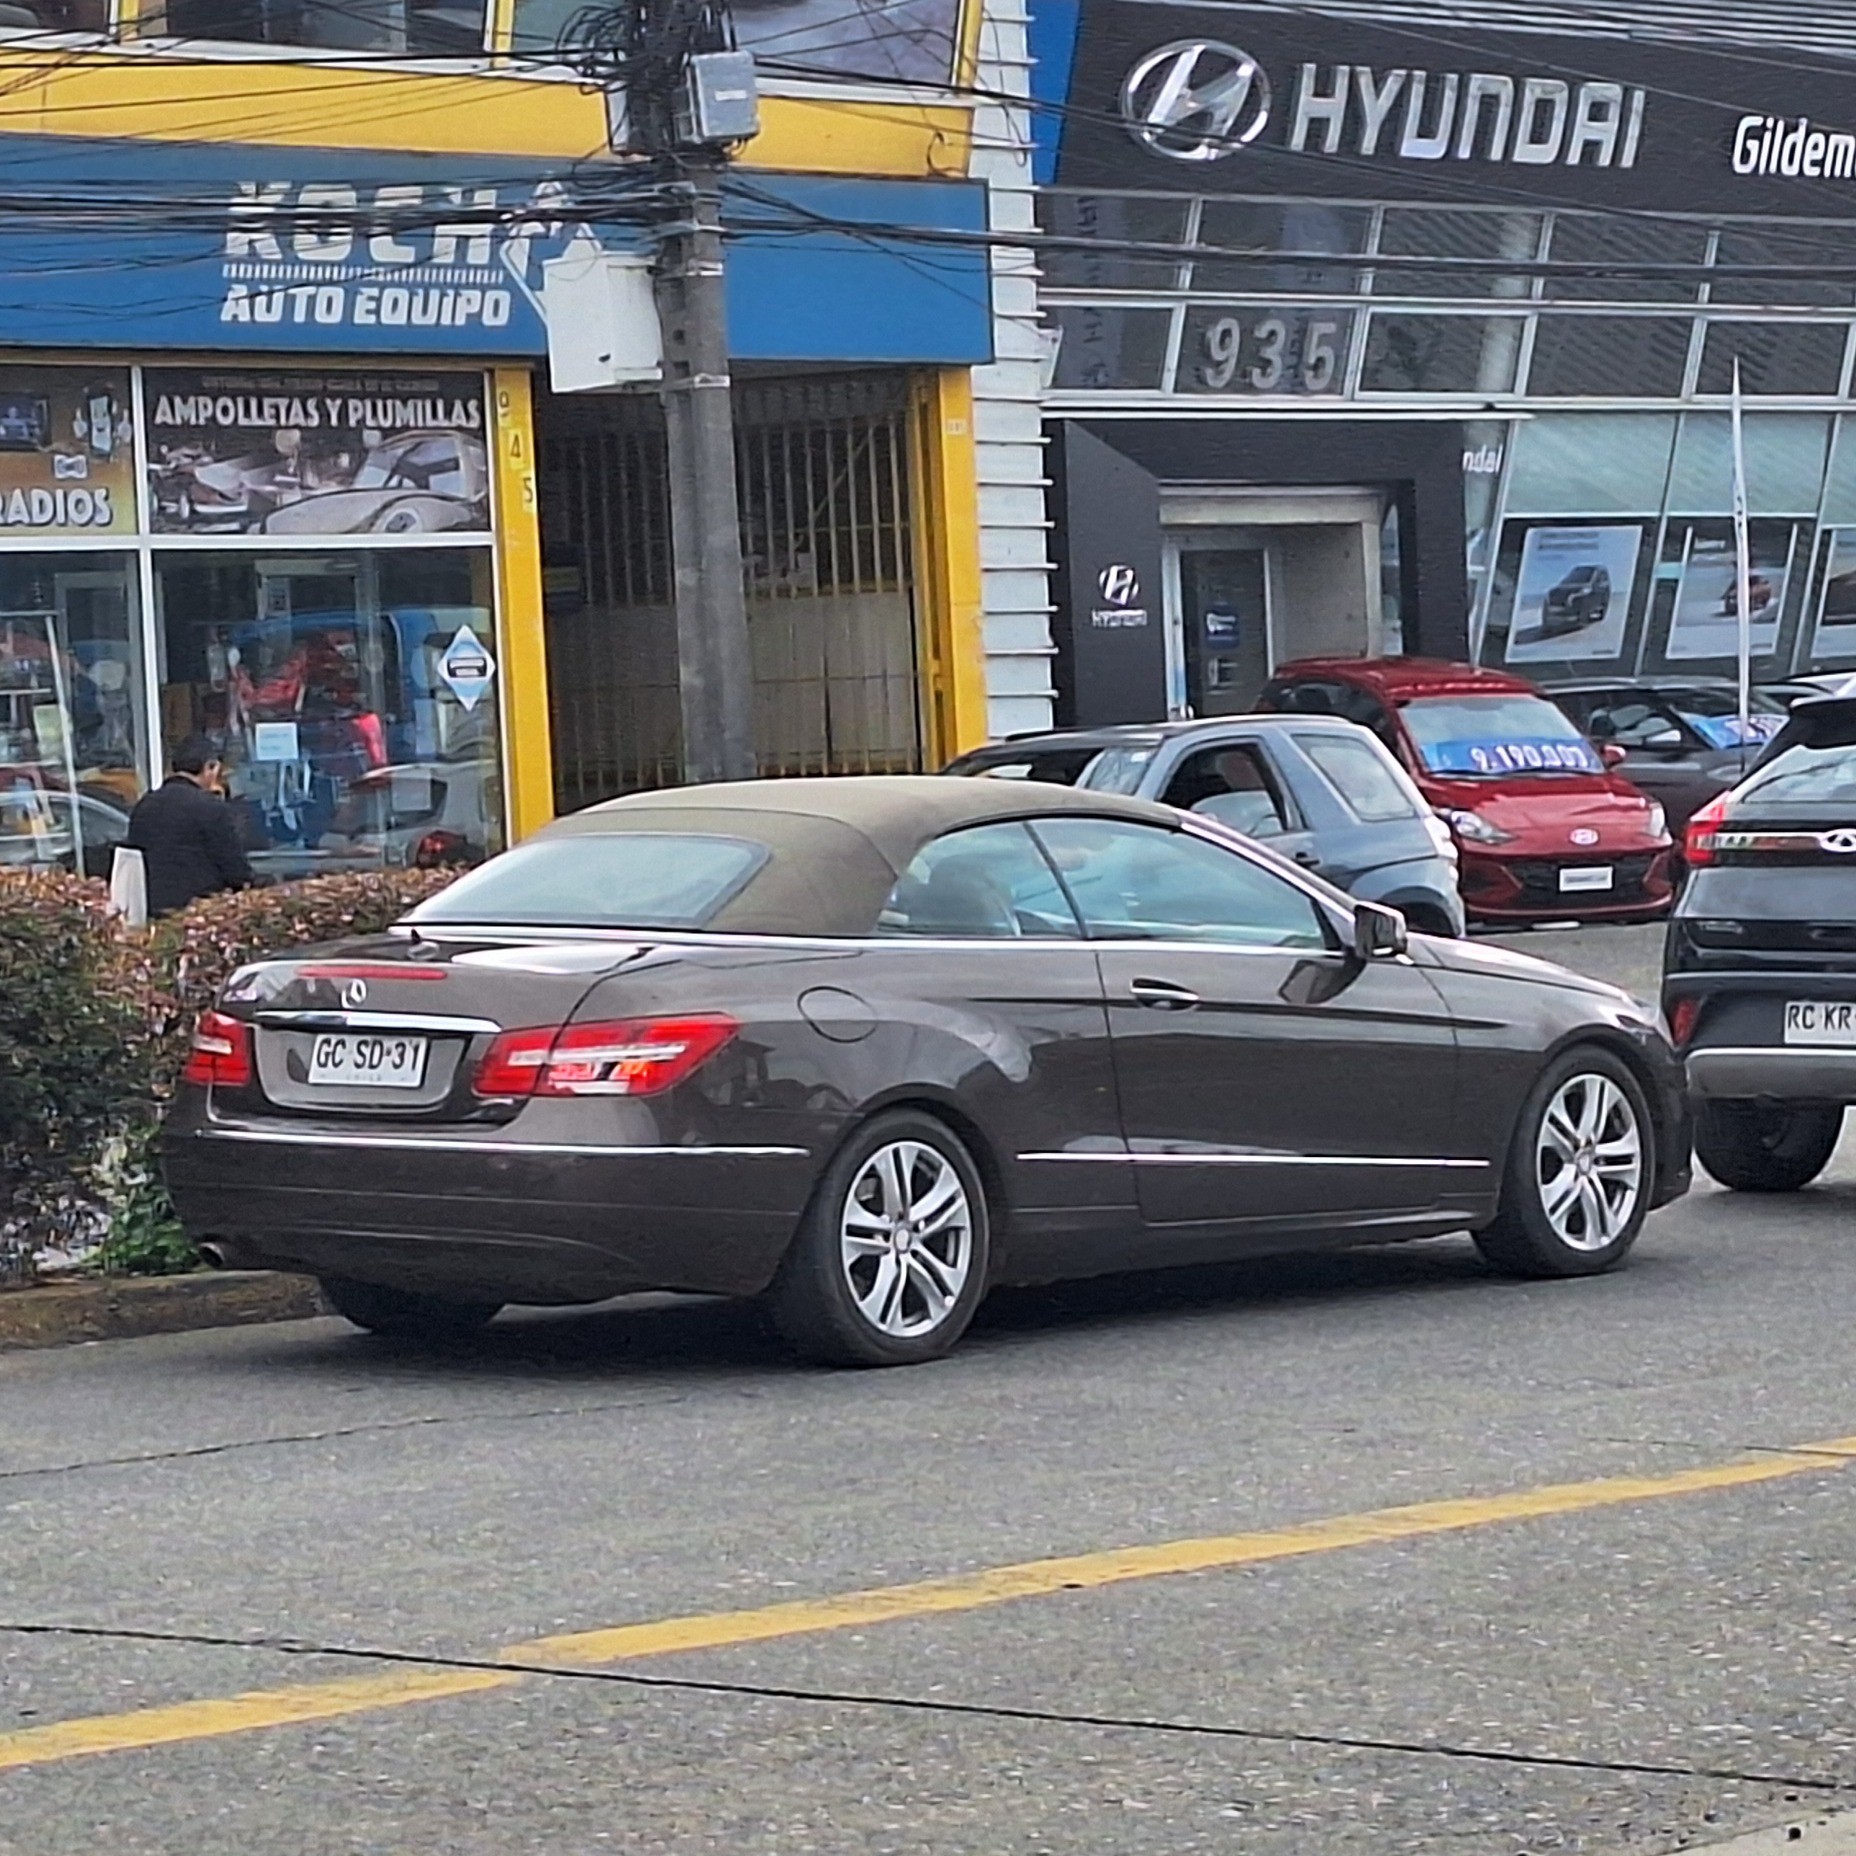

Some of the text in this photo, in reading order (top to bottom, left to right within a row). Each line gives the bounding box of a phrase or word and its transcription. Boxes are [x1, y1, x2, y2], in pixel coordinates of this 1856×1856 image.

[1290, 63, 1646, 168] HYUNDAI
[1732, 116, 1856, 178] Gildem
[225, 181, 498, 265] KOCH
[220, 284, 511, 326] AUTO EQUIPO
[1205, 317, 1337, 390] 935
[153, 396, 482, 429] AMPOLLETAS Y PLUMILLAS
[0, 488, 112, 526] ADIOS
[1787, 1004, 1851, 1031] RC KR
[316, 1037, 347, 1069] GC
